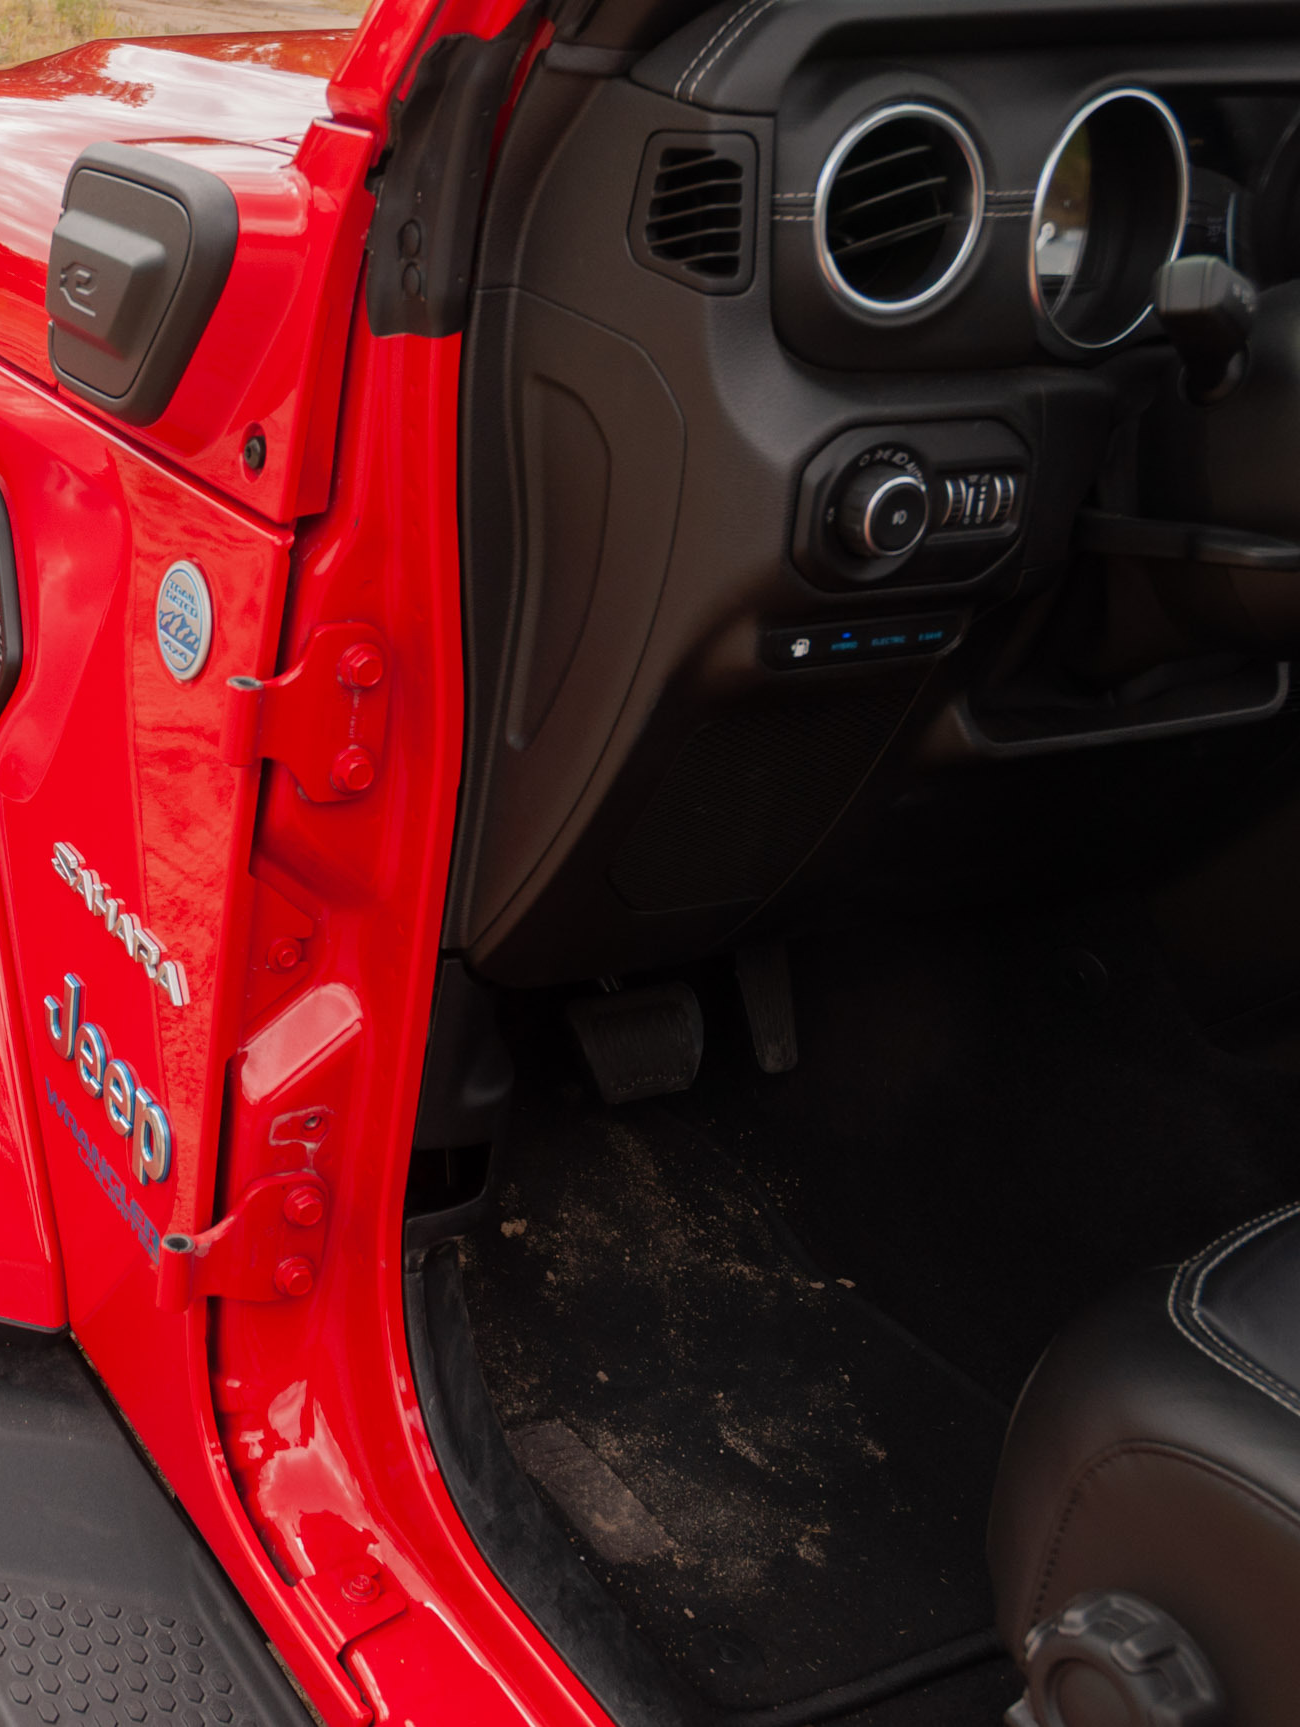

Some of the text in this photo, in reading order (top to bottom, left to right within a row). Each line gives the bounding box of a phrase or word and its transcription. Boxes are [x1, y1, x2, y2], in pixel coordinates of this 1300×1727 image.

[165, 589, 198, 619] RATED
[169, 579, 196, 606] TRAIL
[871, 635, 906, 646] ELECTRIC
[52, 842, 186, 1006] SAHARA
[44, 973, 172, 1186] Jeep
[45, 1075, 160, 1251] WRANGLER
[78, 1146, 160, 1265] UNLIMITED
